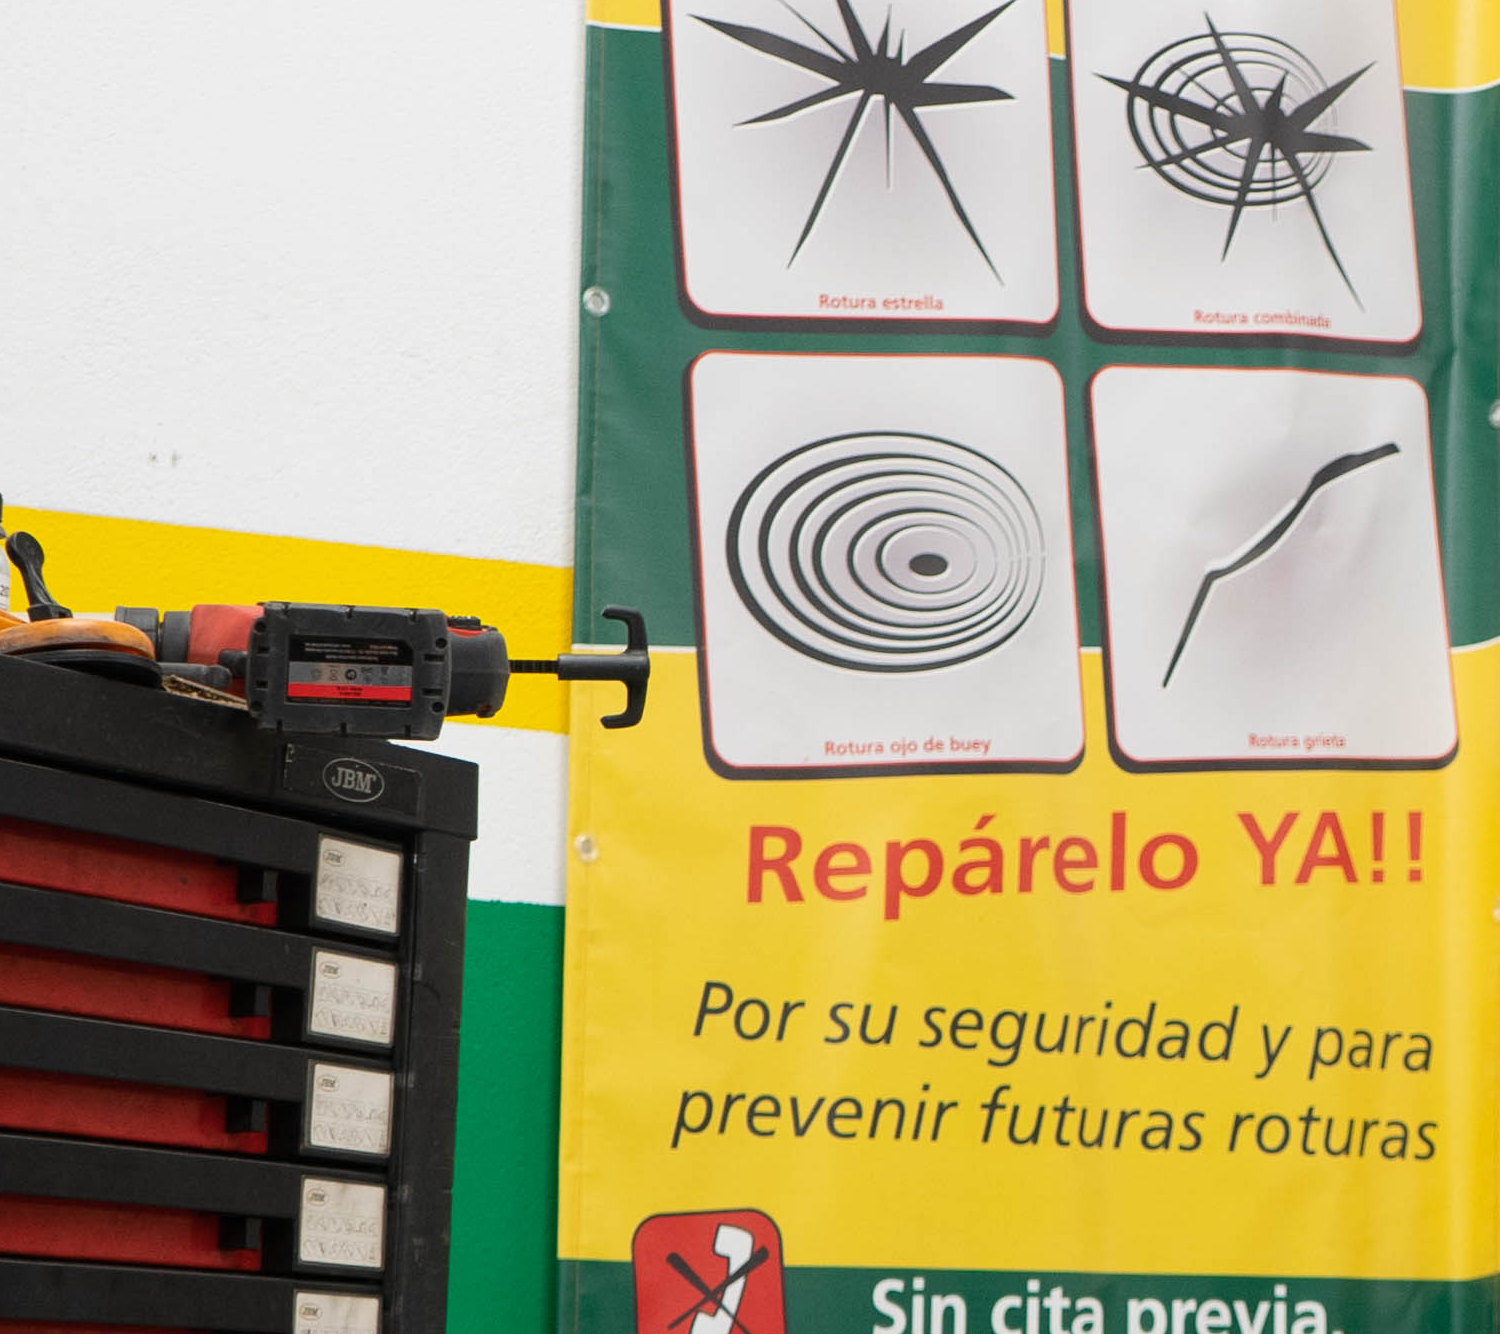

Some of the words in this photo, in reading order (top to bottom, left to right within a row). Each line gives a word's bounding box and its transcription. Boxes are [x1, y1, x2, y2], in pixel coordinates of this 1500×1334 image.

[819, 293, 876, 309] Rotura
[882, 294, 944, 310] estrella
[1194, 309, 1248, 324] Rotura
[824, 740, 884, 755] Rotura
[890, 737, 918, 756] ojo
[923, 735, 945, 752] de
[949, 734, 992, 755] buey
[1248, 732, 1299, 748] Rotura
[332, 767, 377, 793] JBM
[745, 812, 1200, 921] Repárelo
[1237, 810, 1426, 887] YA!!
[692, 980, 805, 1043] Por
[825, 998, 898, 1045] su
[919, 1002, 1238, 1068] seguridad
[1255, 1023, 1291, 1078] y
[1309, 1025, 1435, 1081] para
[671, 1084, 961, 1150] prevenir
[978, 1084, 1204, 1153] futuras
[1227, 1100, 1439, 1161] roturas
